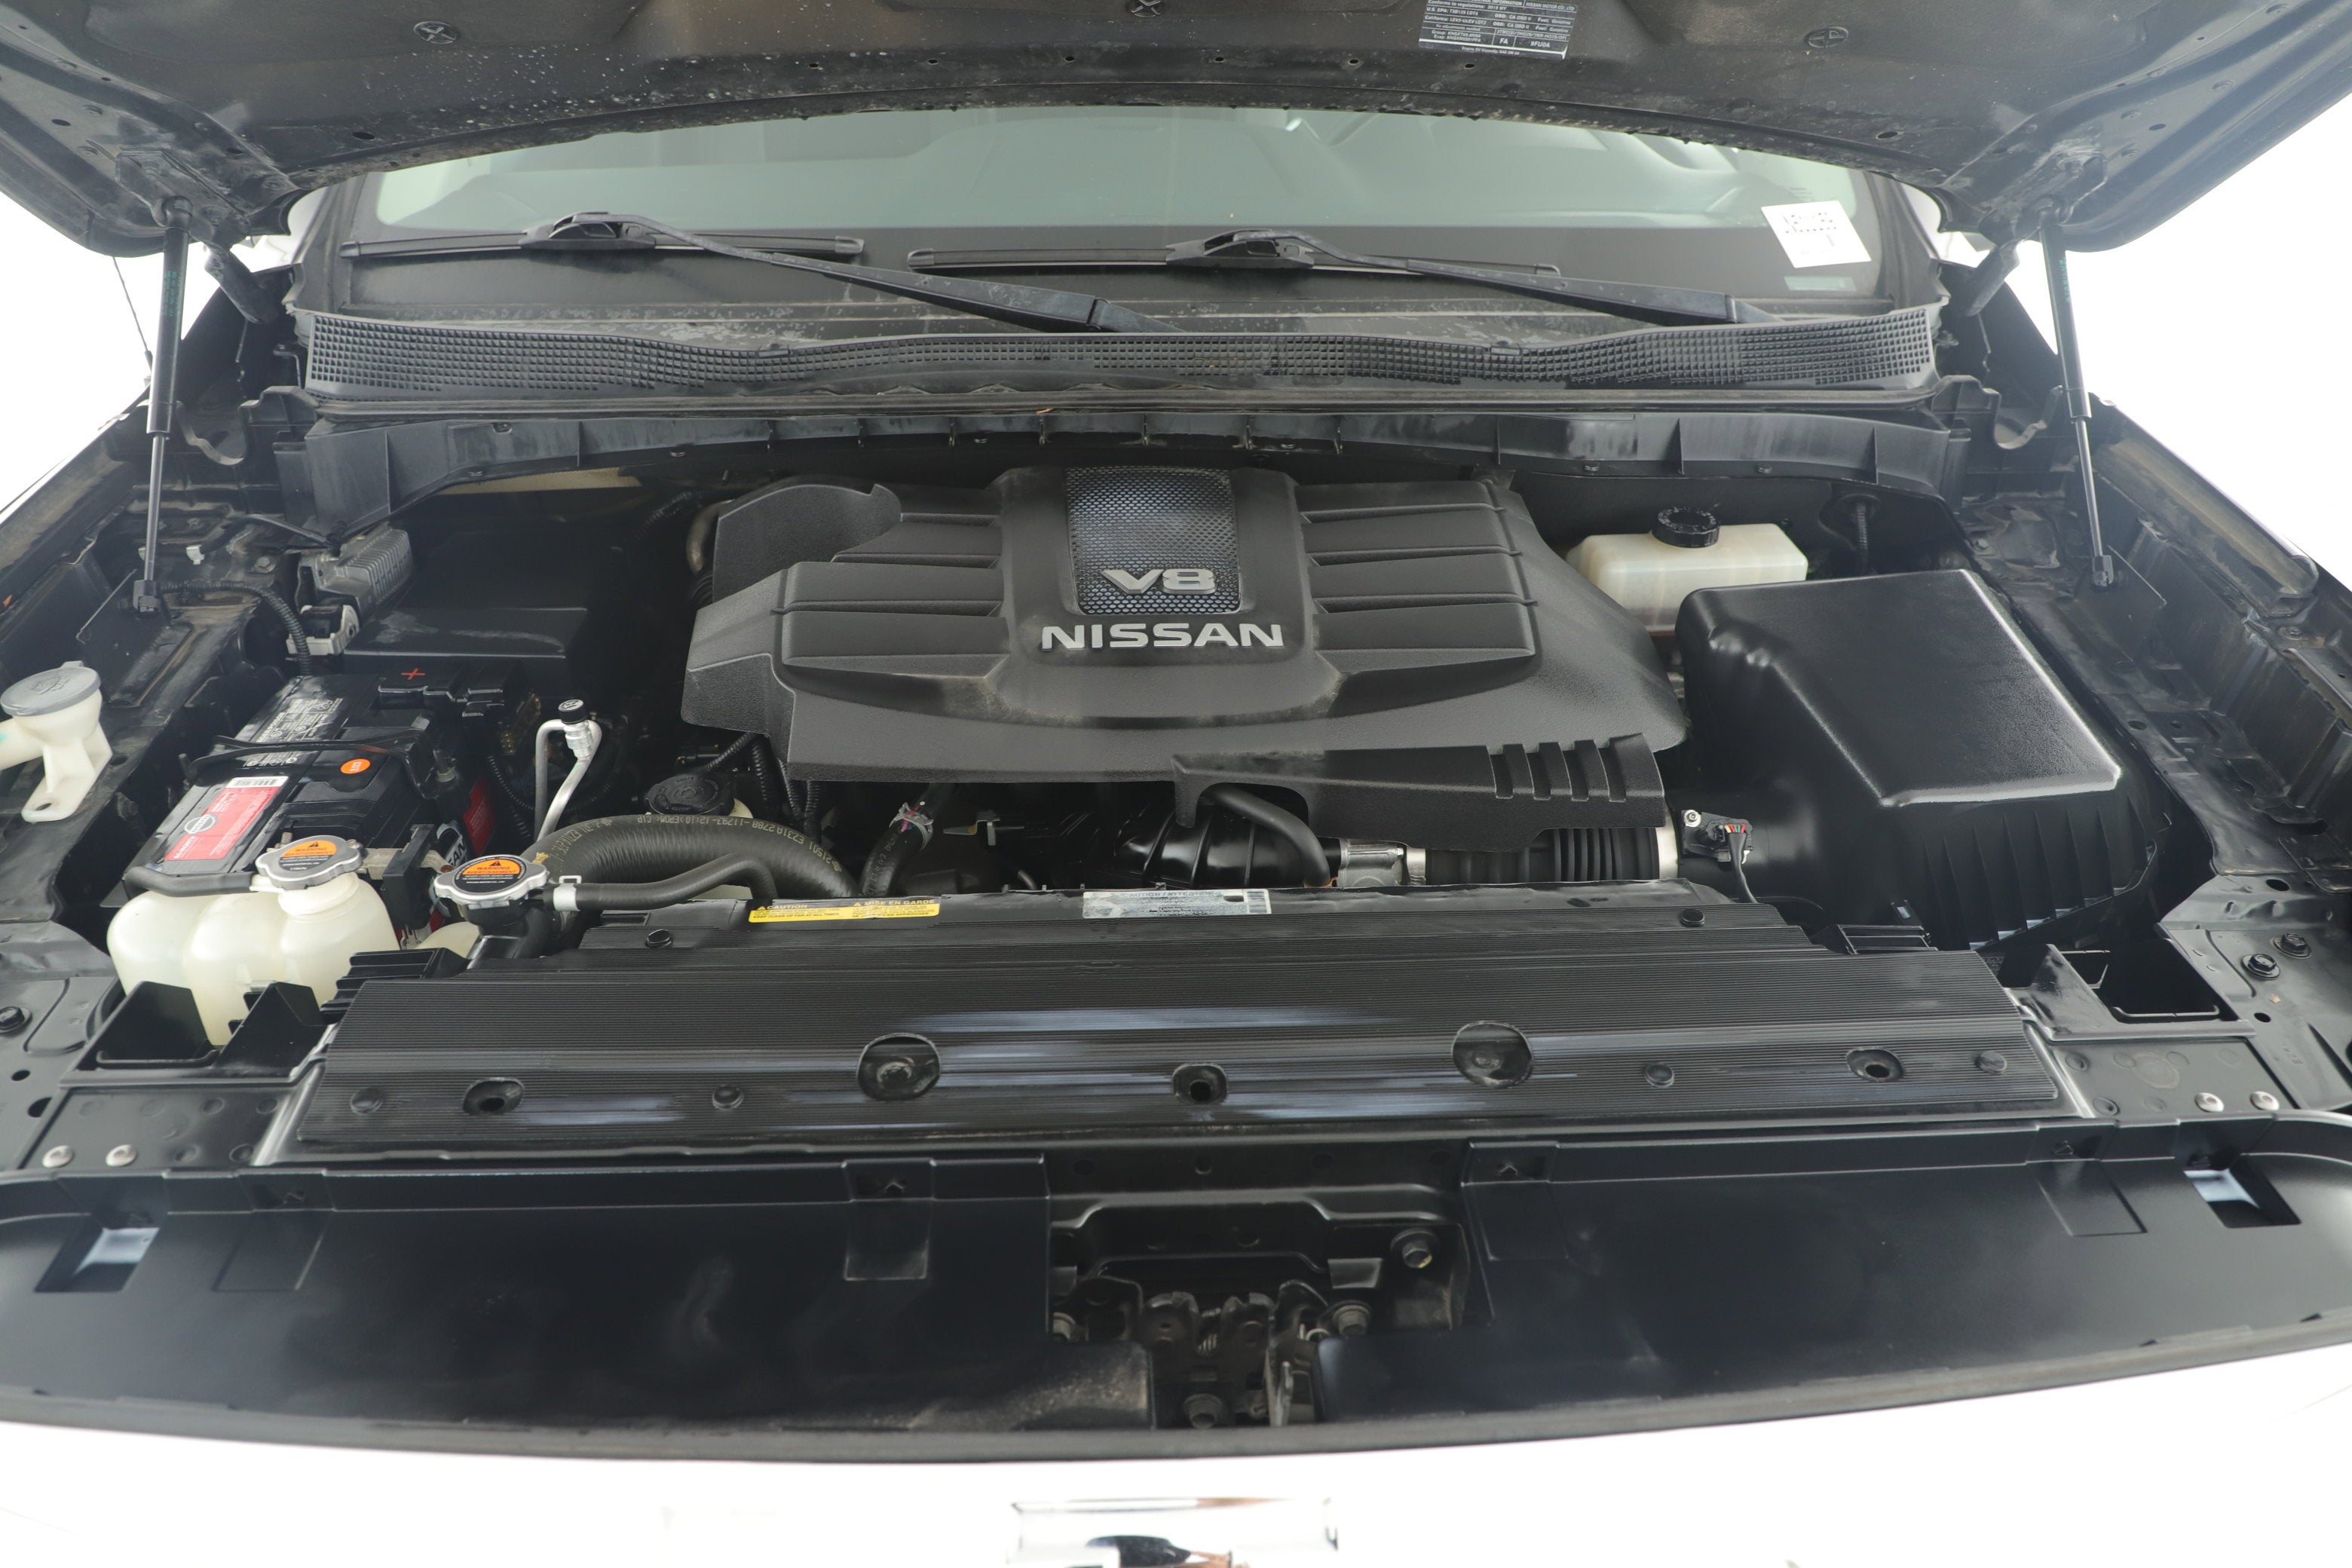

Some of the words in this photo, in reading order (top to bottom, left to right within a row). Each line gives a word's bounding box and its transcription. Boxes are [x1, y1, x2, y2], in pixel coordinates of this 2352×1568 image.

[1101, 568, 1218, 595] V8
[1042, 623, 1284, 651] NISSAN
[808, 841, 832, 864] 21501
